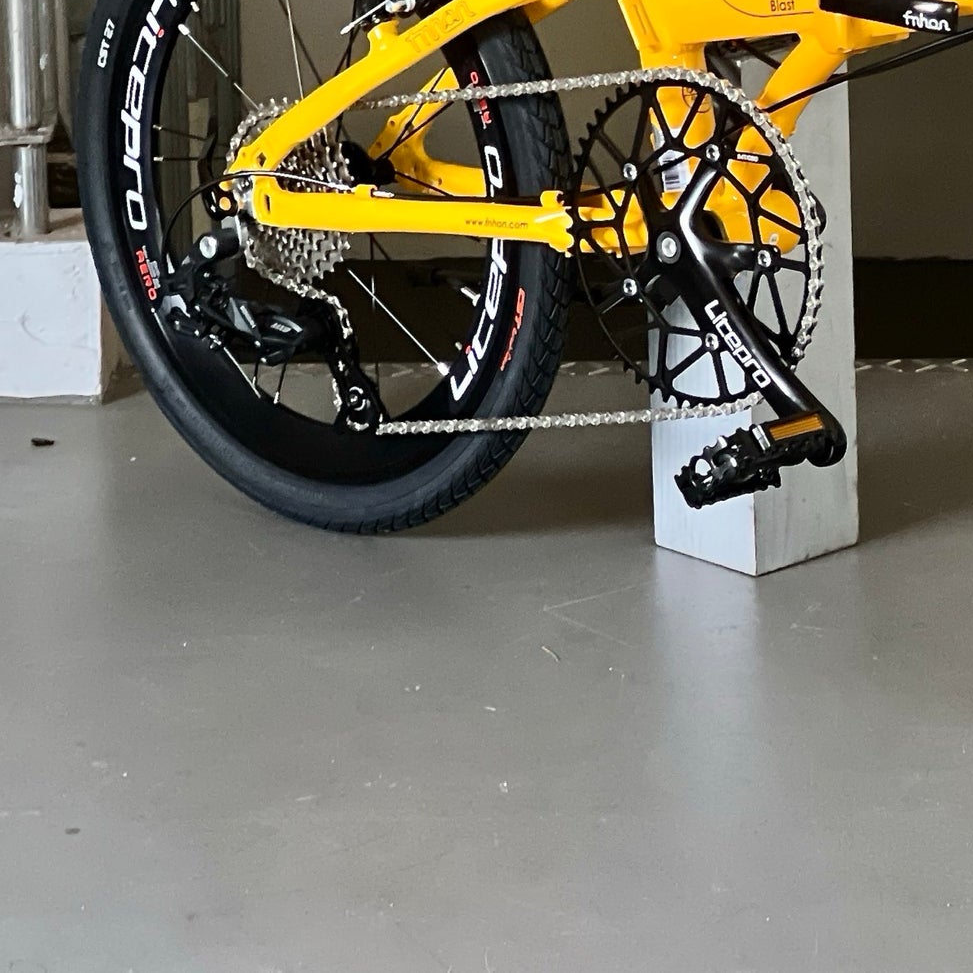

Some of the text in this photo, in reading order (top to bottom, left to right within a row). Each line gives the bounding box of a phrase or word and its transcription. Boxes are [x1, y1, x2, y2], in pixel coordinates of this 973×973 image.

[97, 18, 116, 68] CST 27
[902, 9, 951, 32] fnhon
[465, 217, 529, 230] www.fnhon.com
[135, 249, 157, 302] AERO
[704, 299, 772, 389] Litepro
